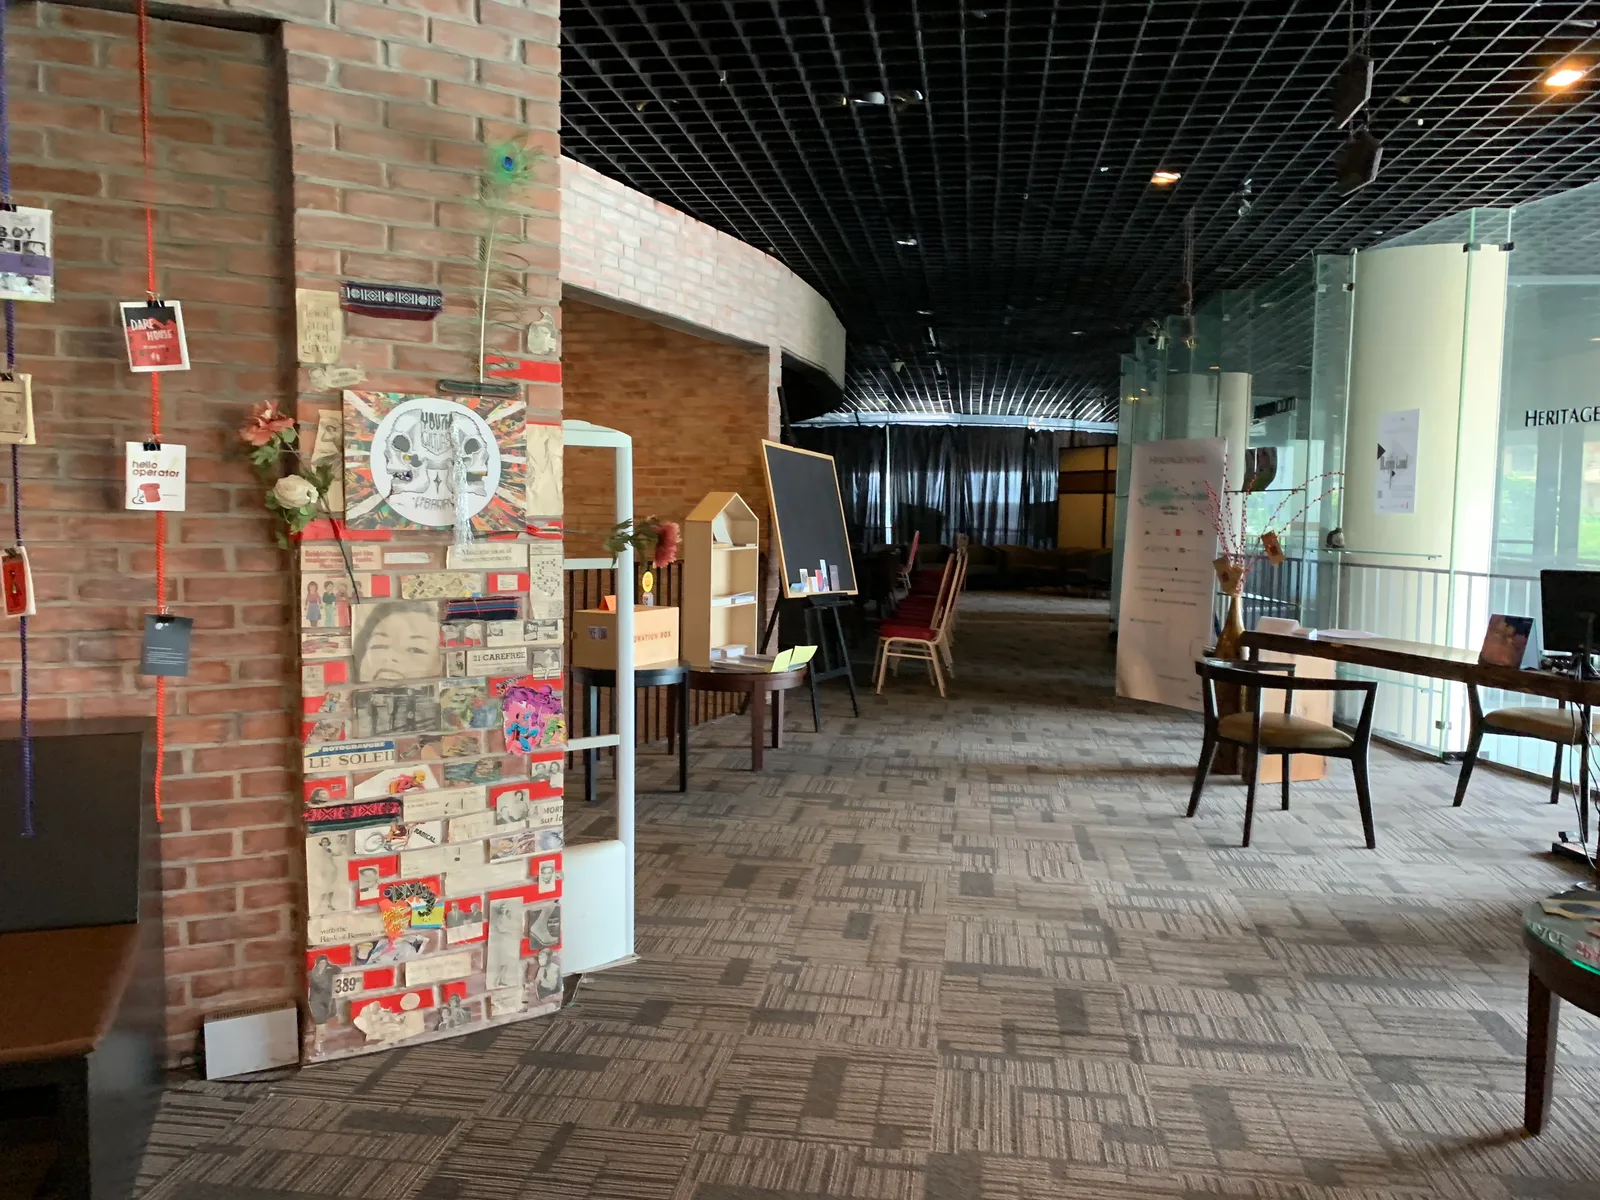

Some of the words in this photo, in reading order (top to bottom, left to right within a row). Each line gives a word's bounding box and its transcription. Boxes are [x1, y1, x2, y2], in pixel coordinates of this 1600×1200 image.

[146, 329, 173, 341] HOUSE
[1525, 406, 1600, 427] HERITAGE
[132, 460, 158, 469] hello
[132, 469, 180, 478] operator
[660, 631, 671, 639] BOX
[483, 651, 526, 662] CAREFREE
[309, 757, 331, 768] LE
[414, 828, 436, 844] RADICAL
[334, 976, 356, 994] 389
